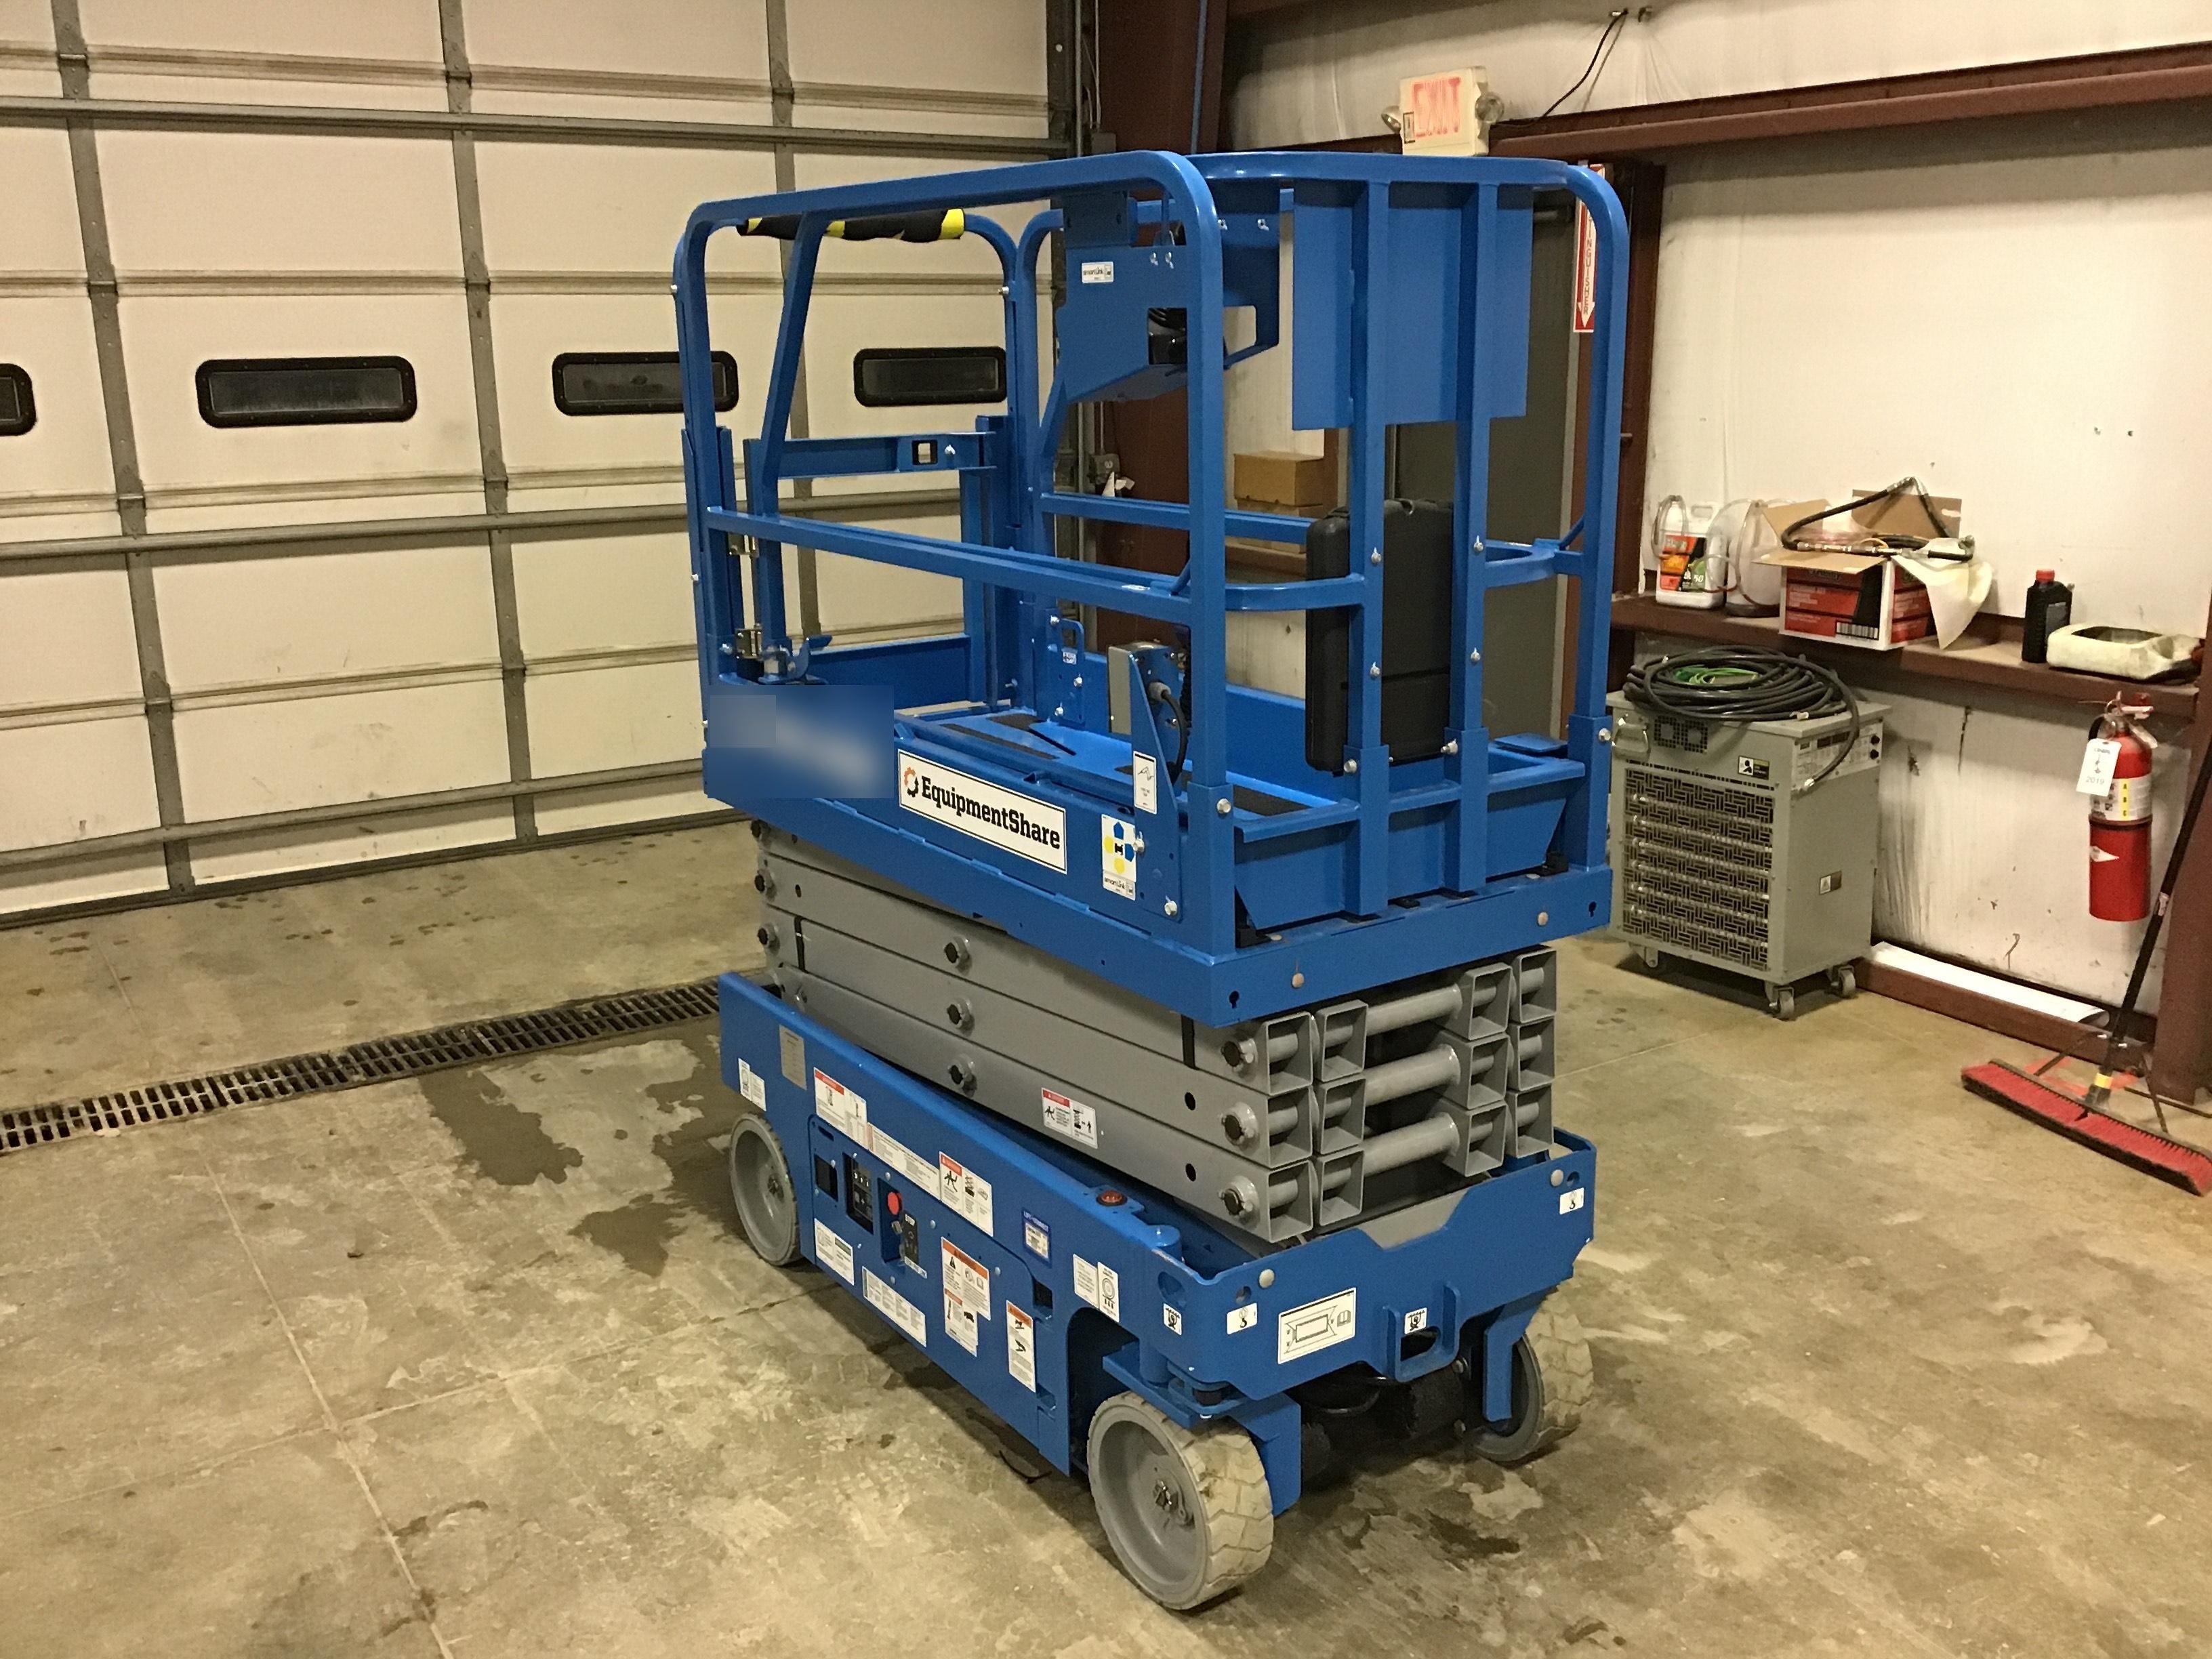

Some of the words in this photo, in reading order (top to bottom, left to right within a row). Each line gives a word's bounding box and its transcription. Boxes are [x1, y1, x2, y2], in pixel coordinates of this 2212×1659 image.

[1412, 77, 1461, 138] EXIT
[1583, 215, 1594, 315] TINGUISHER
[922, 775, 1060, 850] EquipmentShare
[2085, 775, 2105, 785] 2019
